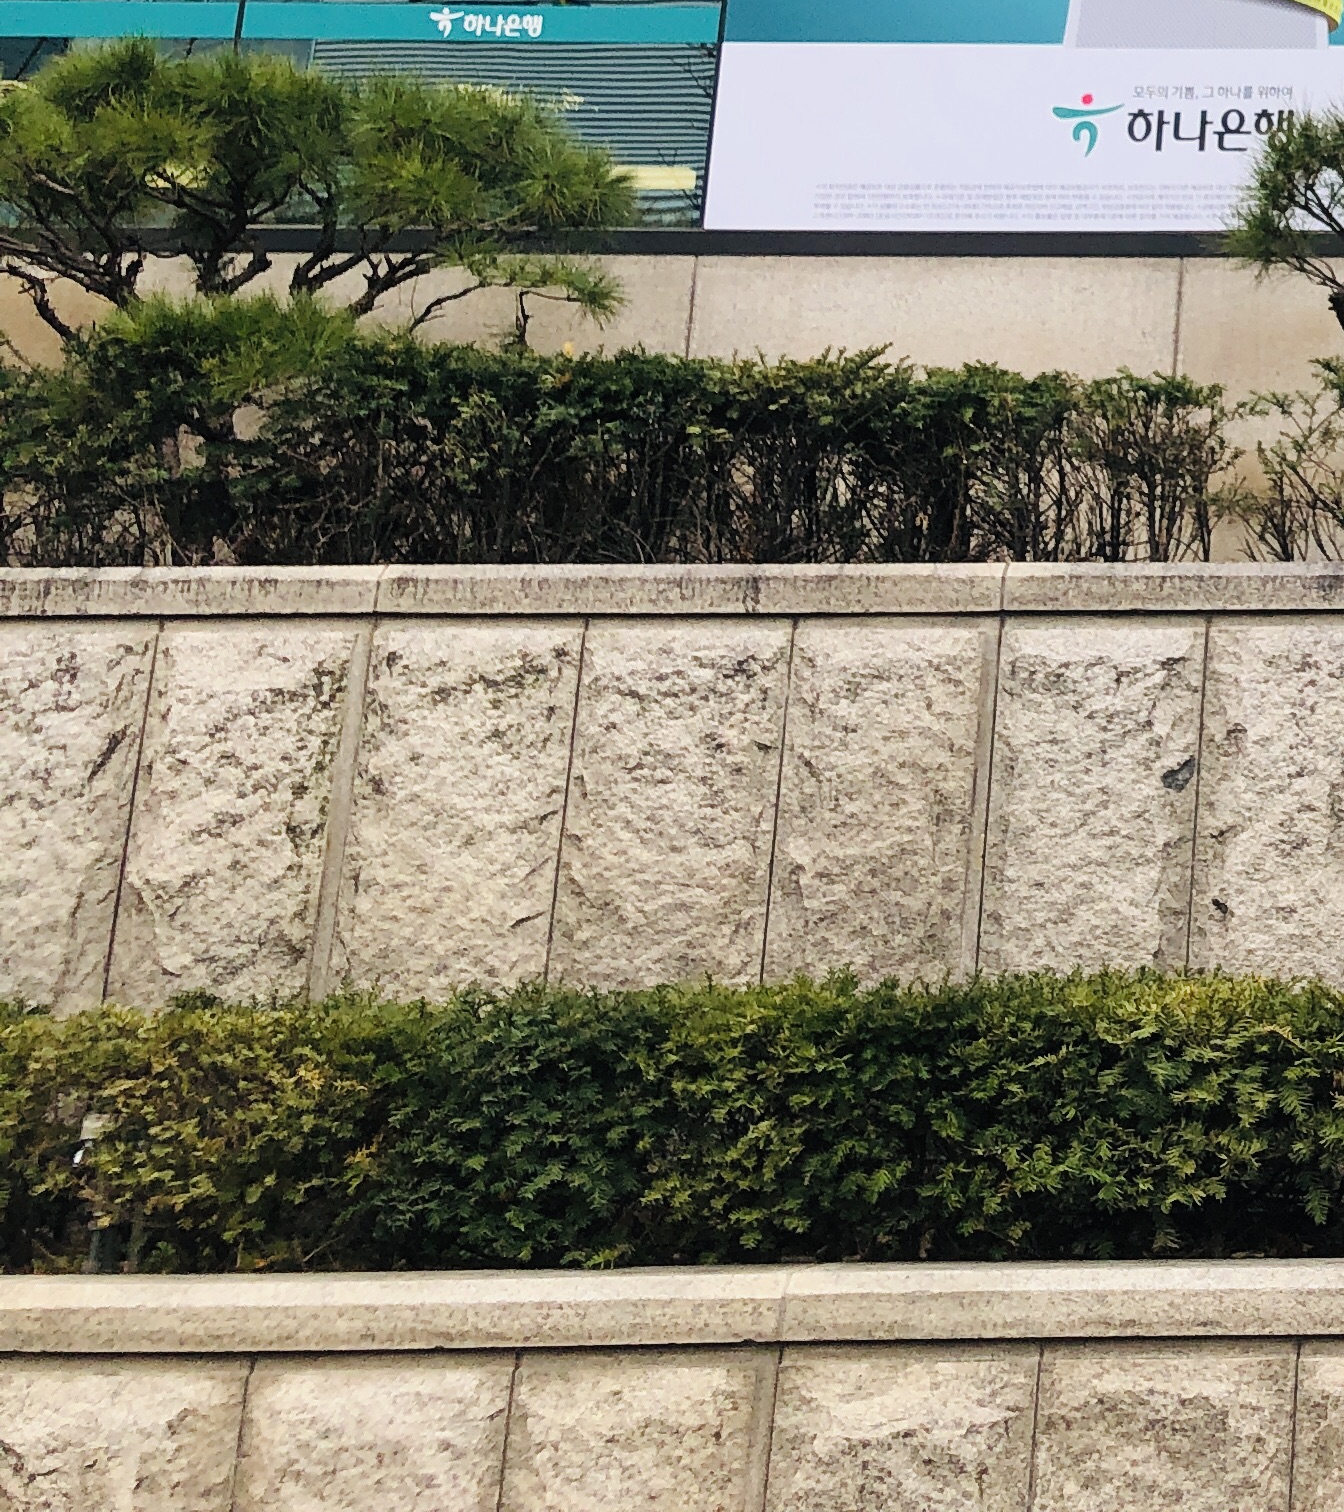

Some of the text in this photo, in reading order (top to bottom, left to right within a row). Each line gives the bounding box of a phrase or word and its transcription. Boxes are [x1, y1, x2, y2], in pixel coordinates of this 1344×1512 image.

[463, 13, 544, 38] 하나은행
[1133, 86, 1169, 100] 모두의
[1203, 87, 1214, 99] 그
